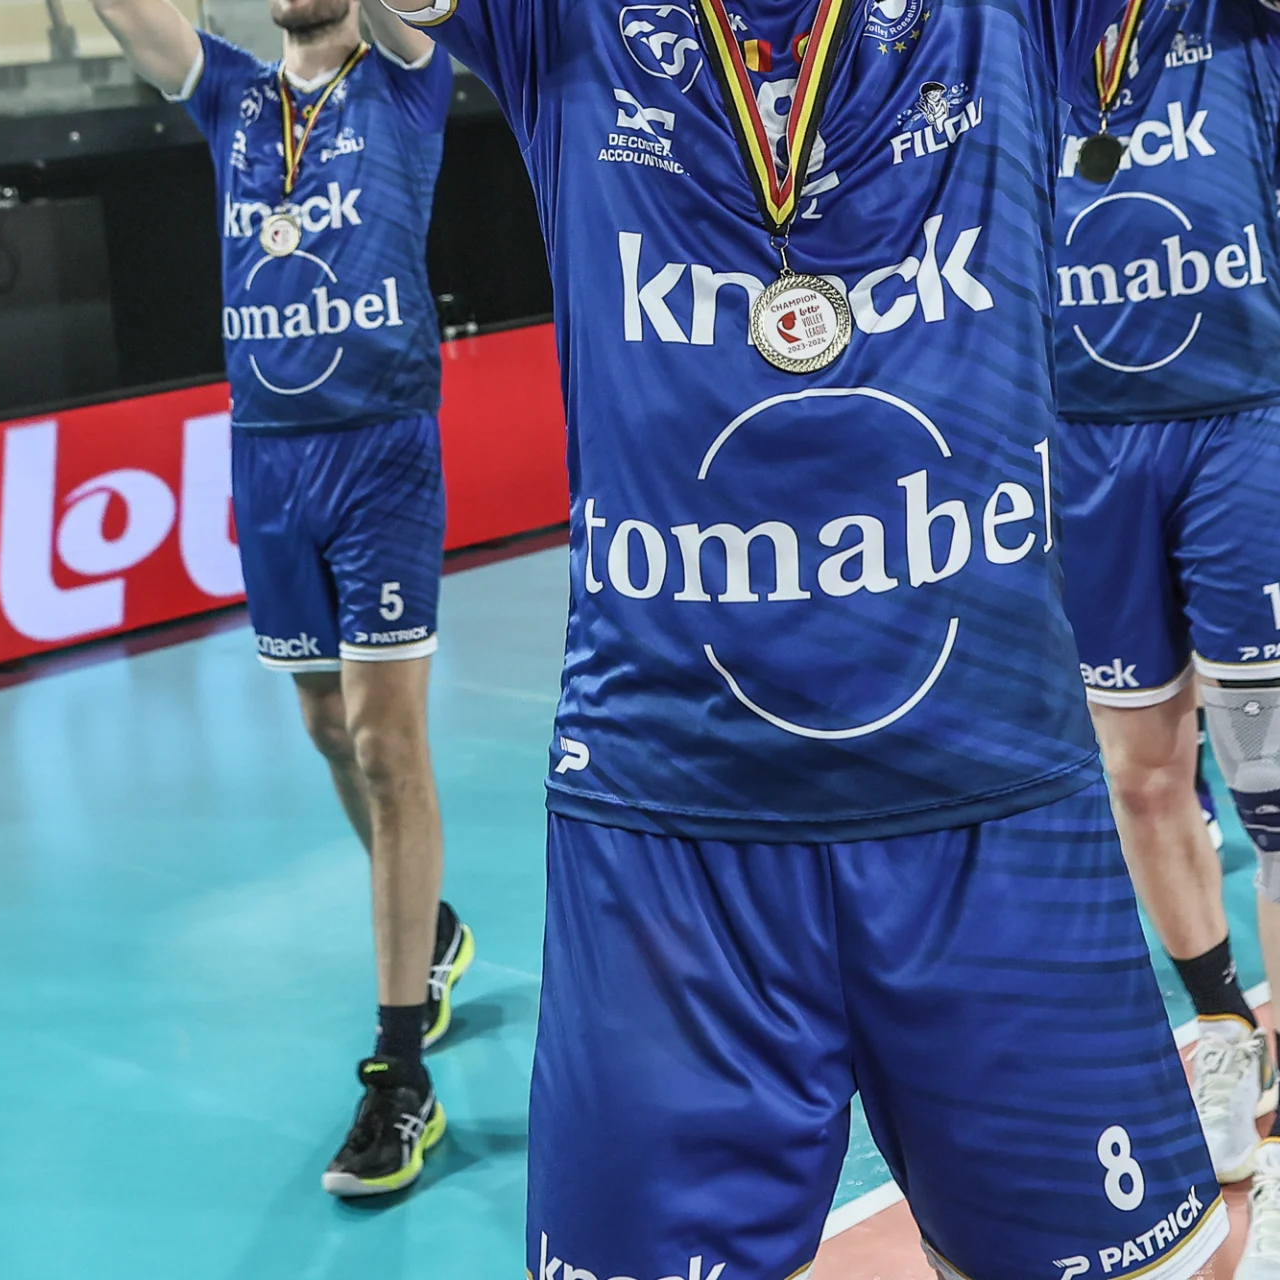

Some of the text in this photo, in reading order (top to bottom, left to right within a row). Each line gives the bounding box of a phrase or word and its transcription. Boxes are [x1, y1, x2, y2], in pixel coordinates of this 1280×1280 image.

[770, 292, 818, 313] CHAMPION
[801, 313, 824, 328] VOLLEY
[805, 323, 828, 339] LEAGUE
[787, 337, 827, 354] 2023-2024
[584, 436, 1055, 603] tomabel
[379, 581, 405, 621] 5
[372, 625, 428, 644] PATRICK
[1096, 1124, 1146, 1212] 8
[1098, 1184, 1204, 1274] PATRICK
